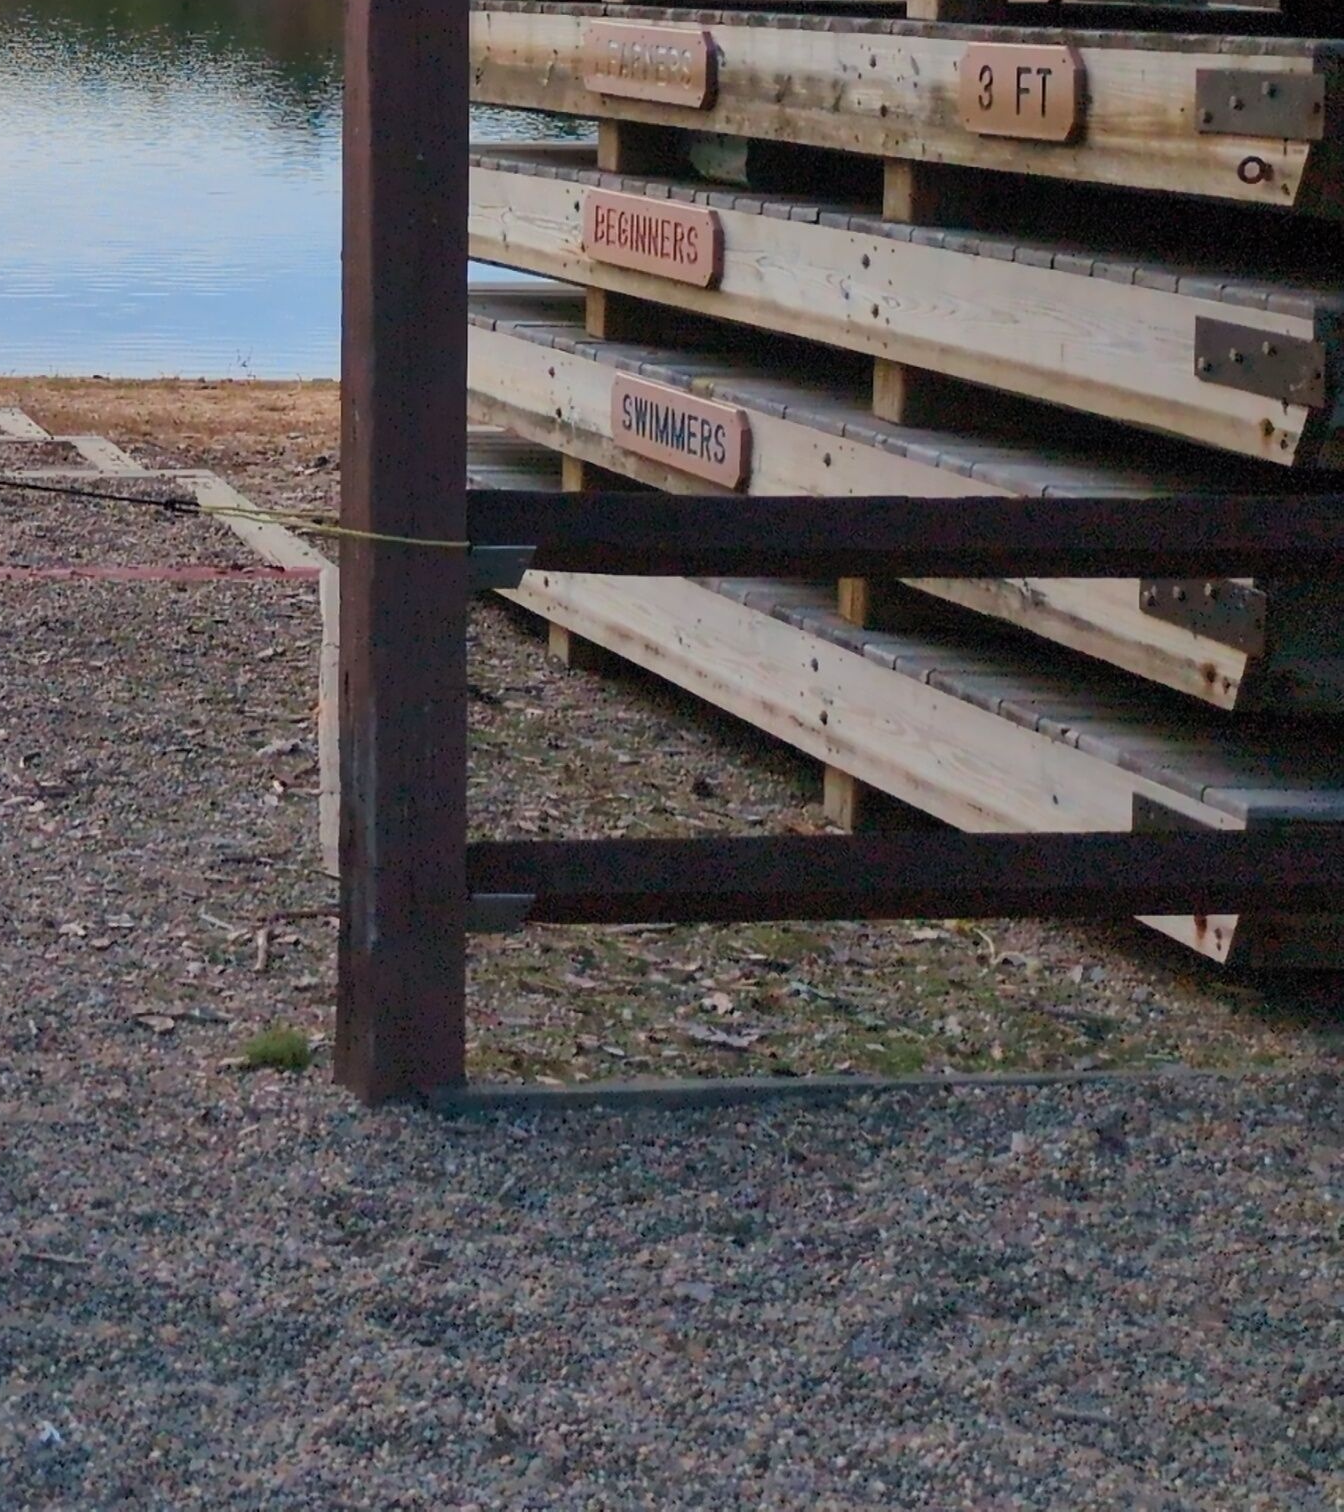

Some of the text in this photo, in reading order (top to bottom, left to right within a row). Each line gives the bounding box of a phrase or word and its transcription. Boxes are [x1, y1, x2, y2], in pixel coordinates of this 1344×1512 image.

[977, 64, 1053, 118] 3 FT
[593, 204, 699, 265] BEGINNERS
[621, 393, 726, 465] SWIMMERS
